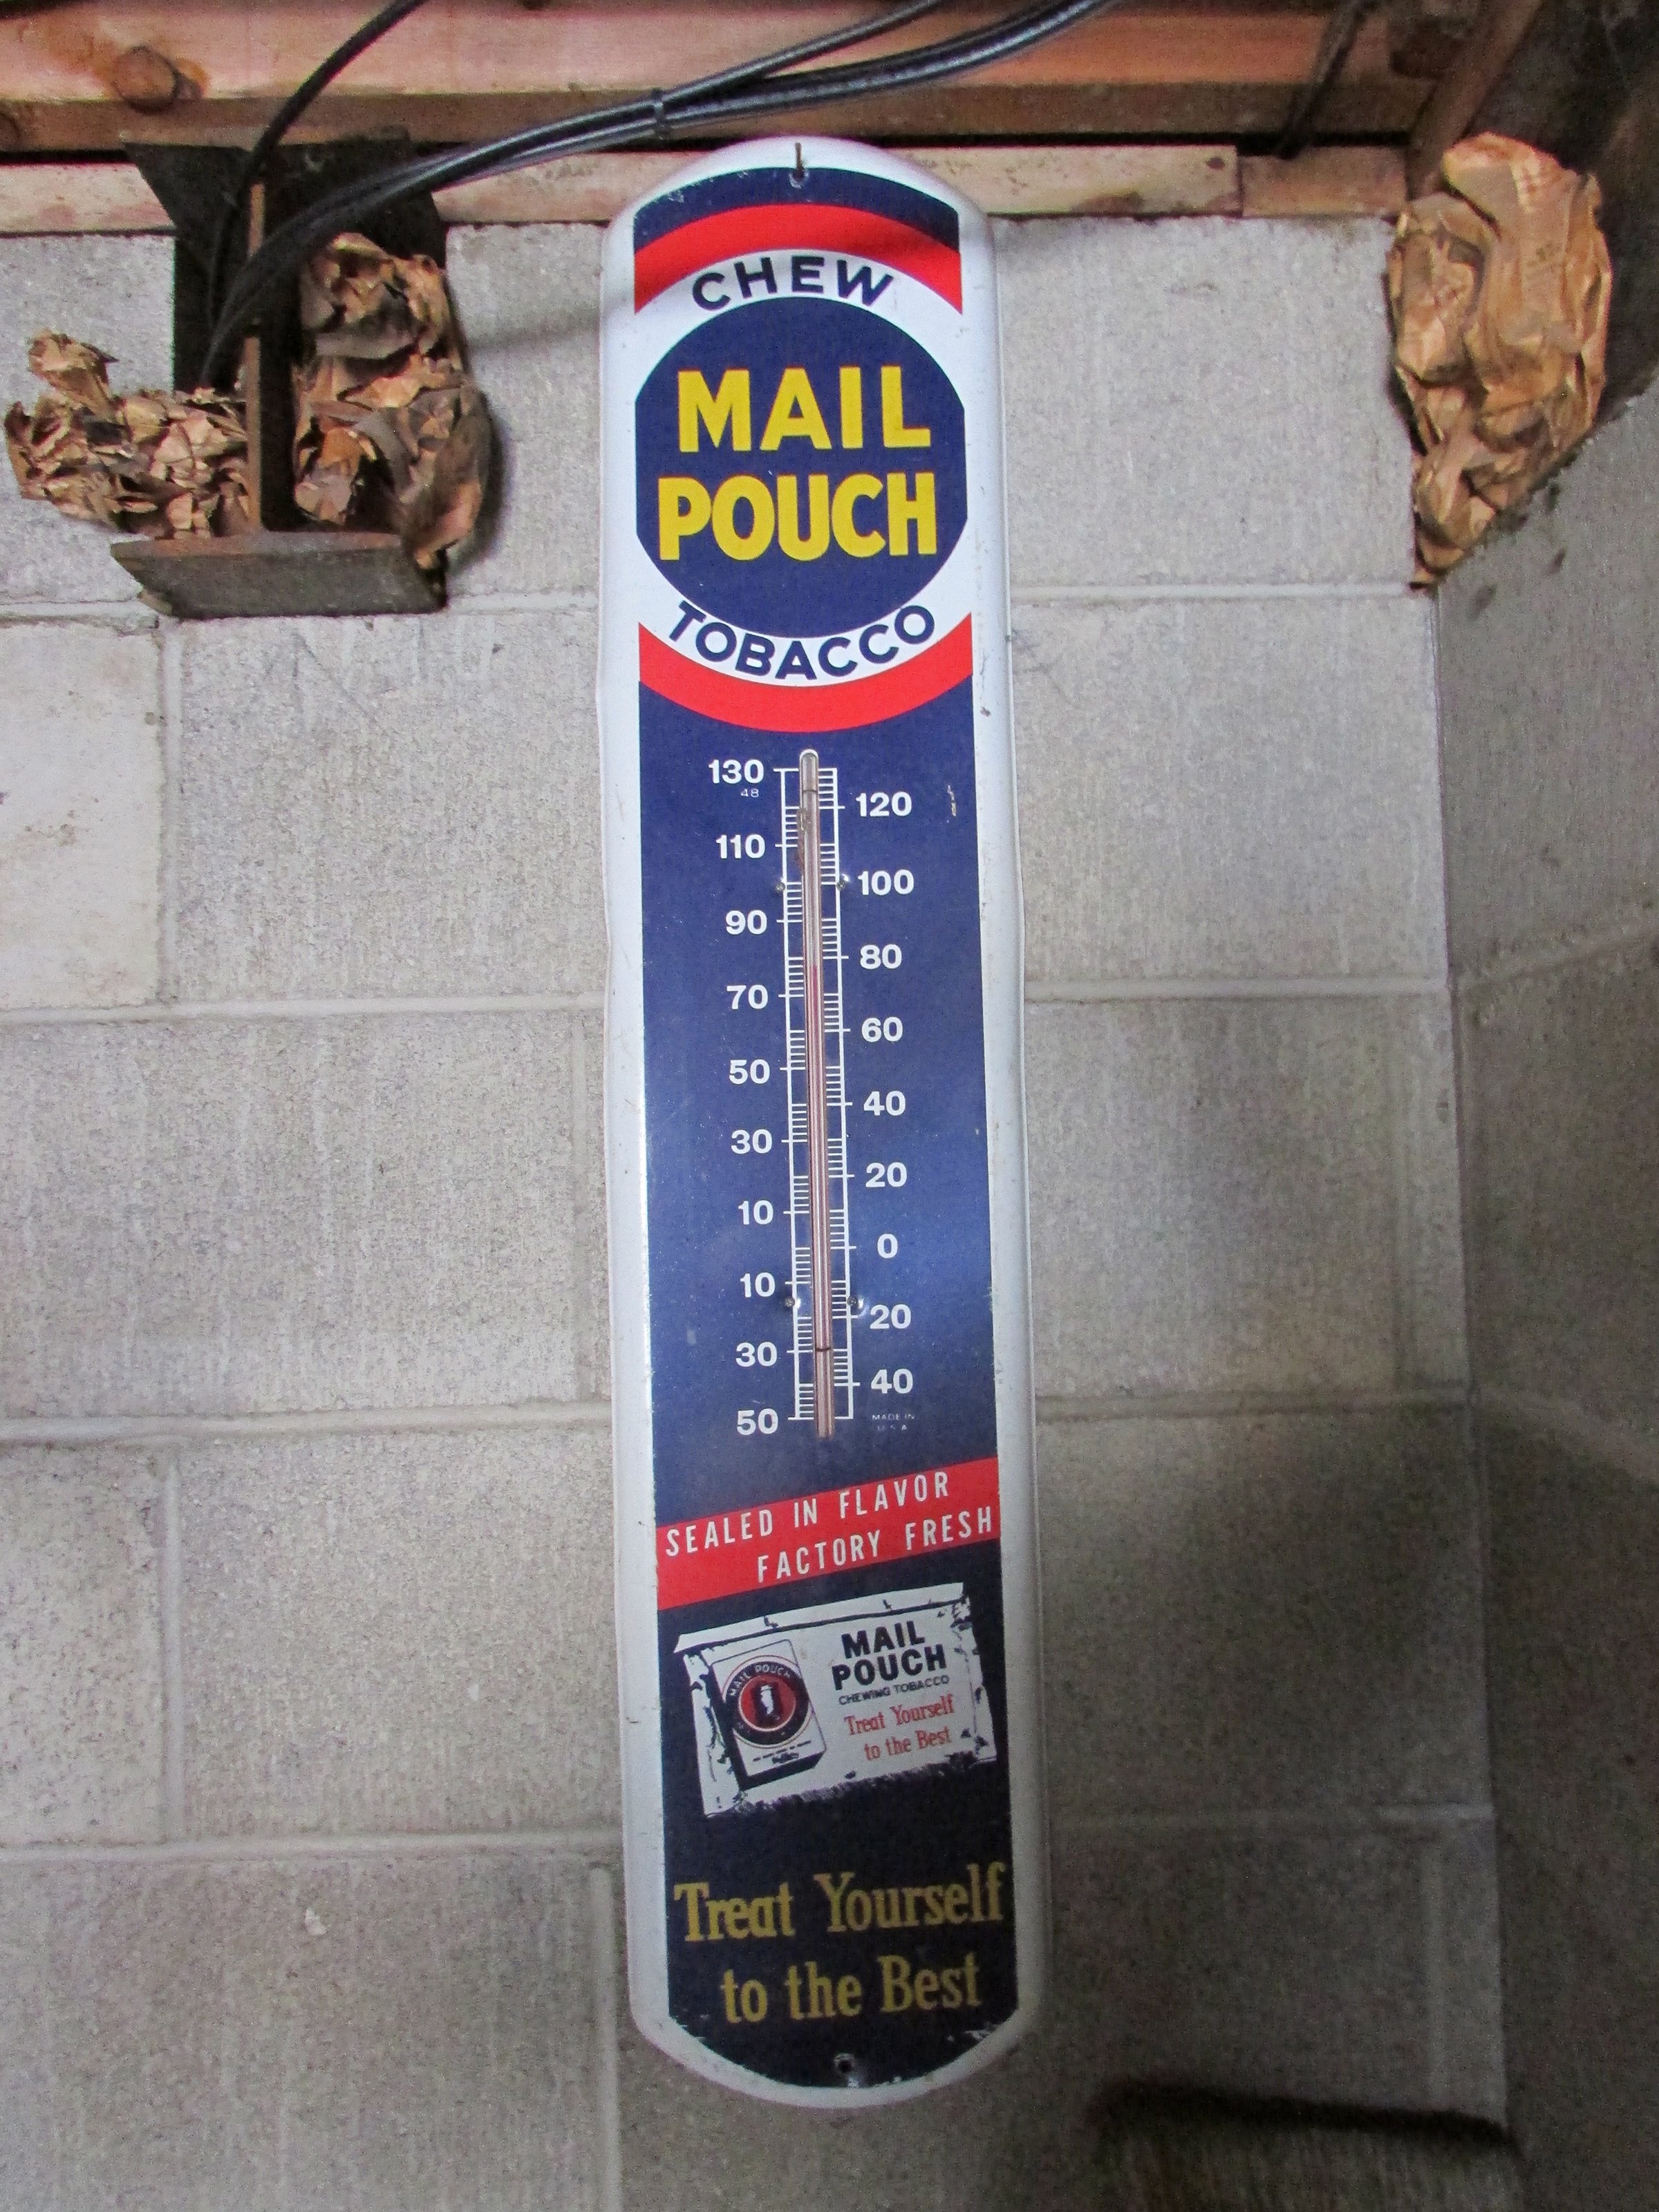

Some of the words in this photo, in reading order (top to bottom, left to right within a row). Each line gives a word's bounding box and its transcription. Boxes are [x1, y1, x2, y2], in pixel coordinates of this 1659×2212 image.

[692, 256, 893, 310] CHEW
[677, 366, 931, 453] MAIL
[657, 471, 937, 561] POUCH
[668, 601, 935, 680] TOBACCO
[708, 759, 764, 784] 130
[740, 789, 759, 798] 48
[856, 791, 912, 817] 120
[715, 834, 765, 859] 110
[858, 869, 914, 895] 100
[725, 910, 767, 935] 90
[860, 944, 902, 969] 80
[727, 985, 768, 1009] 70
[861, 1017, 903, 1042] 60
[729, 1059, 770, 1085] 50
[863, 1091, 906, 1116] 40
[731, 1129, 772, 1154] 30
[865, 1163, 907, 1188] 20
[738, 1200, 774, 1225] 10
[877, 1234, 899, 1258] 0
[740, 1273, 776, 1297] 10
[870, 1304, 911, 1329] 20
[736, 1342, 777, 1367] 30
[870, 1369, 914, 1394] 40
[736, 1409, 778, 1435] 50
[666, 1509, 773, 1557] SEALED
[794, 1498, 818, 1528] IN
[839, 1471, 949, 1519] FLAVOR
[757, 1530, 881, 1583] FACTORY
[906, 1506, 992, 1550] FRESH
[841, 1620, 925, 1658] MAIL
[832, 1644, 946, 1690] POUCH
[838, 1687, 890, 1705] CHEWING
[893, 1674, 950, 1693] TOBACCO
[844, 1712, 885, 1735] Treat
[890, 1693, 954, 1725] Yourself
[864, 1743, 881, 1761] to
[885, 1736, 912, 1756] the
[915, 1725, 952, 1750] Best
[674, 1882, 796, 1941] Treat
[814, 1862, 1006, 1933] Yourself
[720, 1969, 768, 2024] to
[785, 1960, 863, 2021] the
[877, 1952, 983, 2013] Best
